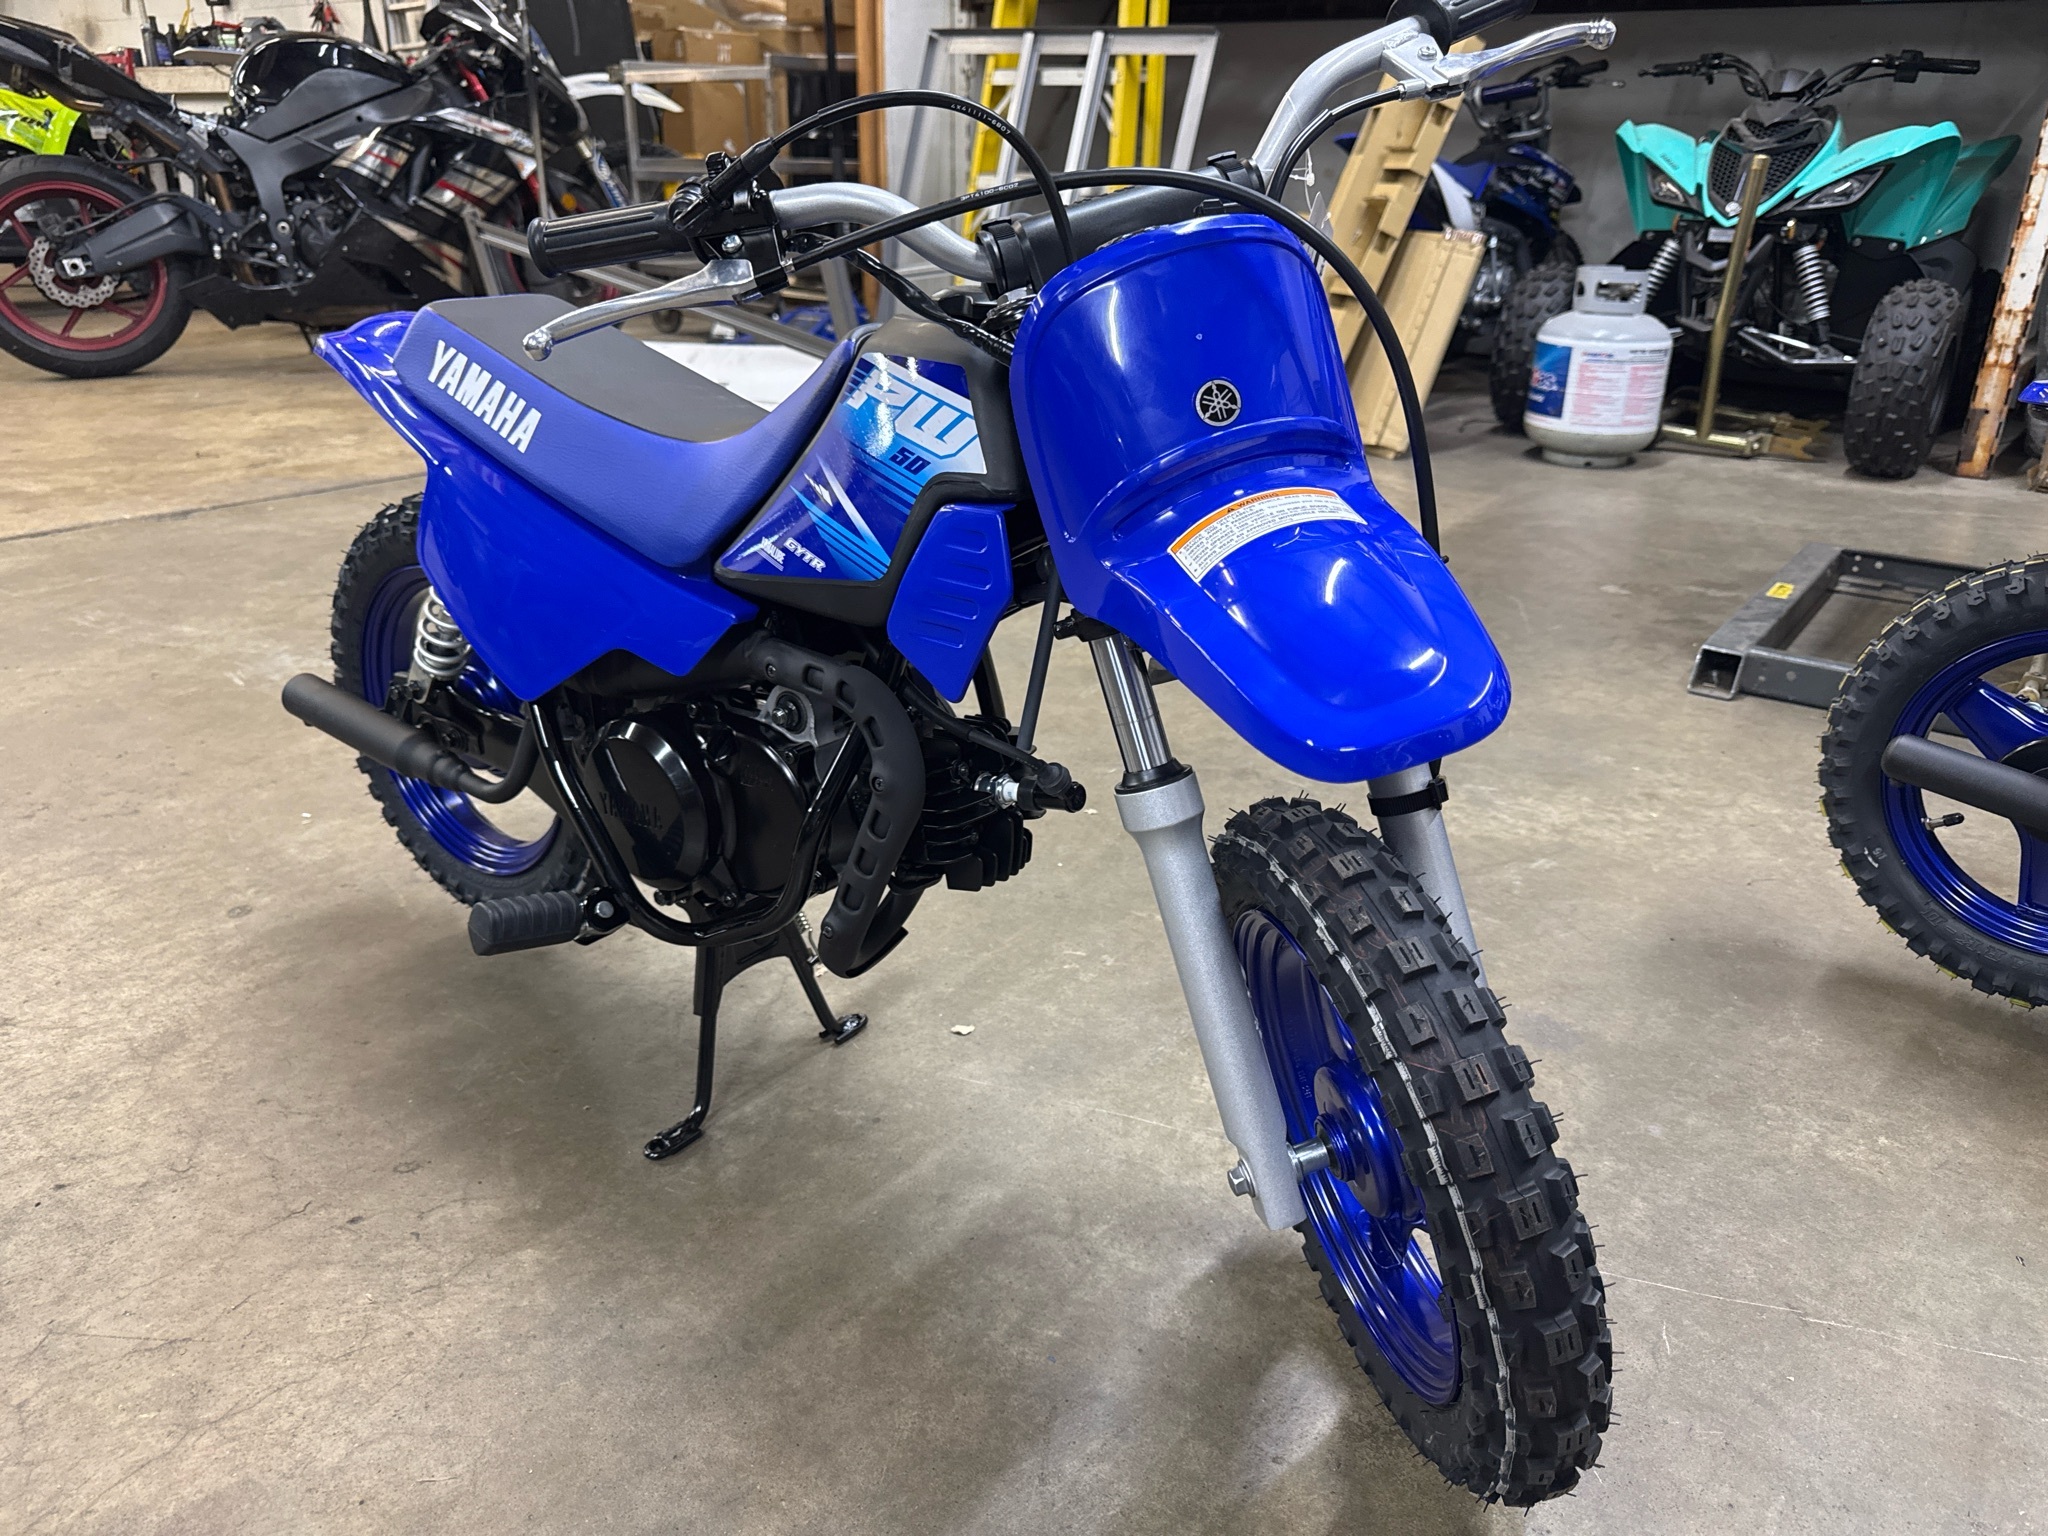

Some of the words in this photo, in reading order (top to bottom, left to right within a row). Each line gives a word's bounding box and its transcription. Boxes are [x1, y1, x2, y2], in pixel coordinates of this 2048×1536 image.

[427, 338, 542, 454] YAMAHA
[846, 366, 979, 460] PW
[888, 446, 931, 476] 50
[1236, 491, 1280, 508] WARNING
[783, 537, 826, 573] GYTR
